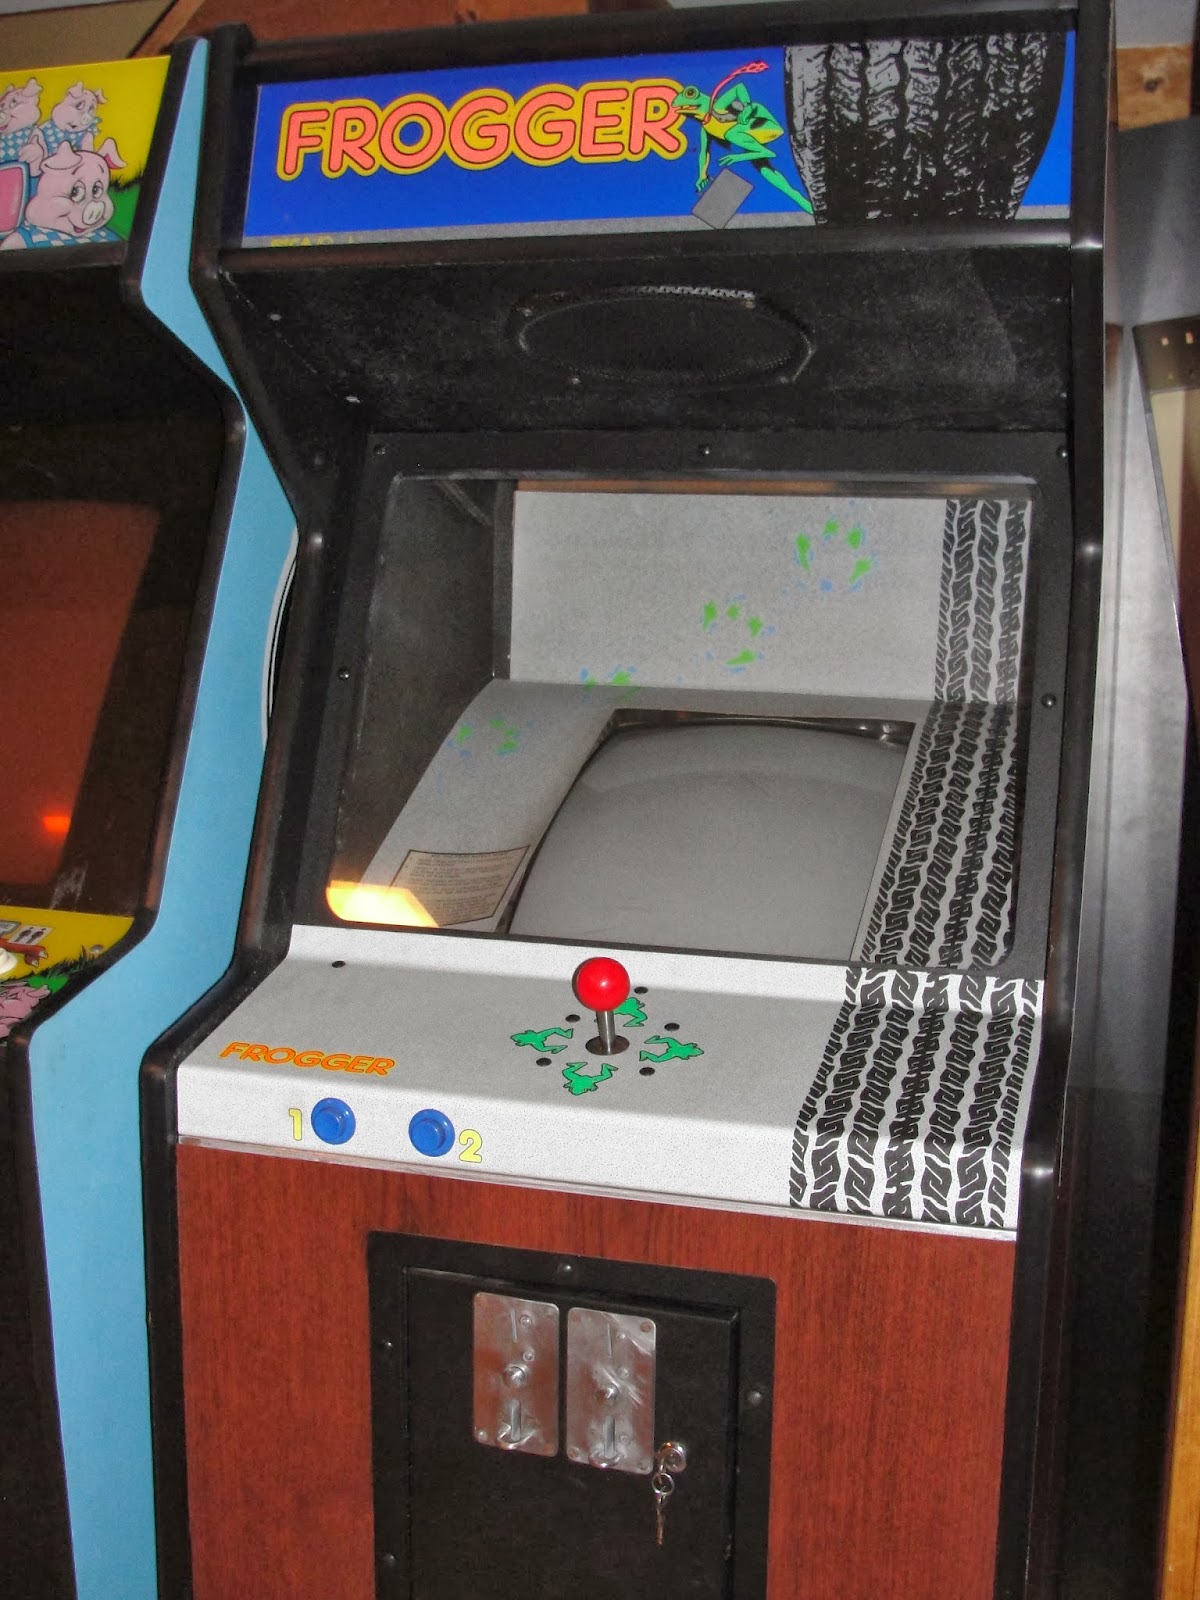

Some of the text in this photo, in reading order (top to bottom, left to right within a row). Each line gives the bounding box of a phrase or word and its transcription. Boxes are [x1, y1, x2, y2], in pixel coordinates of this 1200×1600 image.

[277, 78, 688, 181] FROGGER
[219, 1041, 395, 1077] FROGGER
[288, 1107, 303, 1142] 1
[458, 1128, 483, 1163] 2
